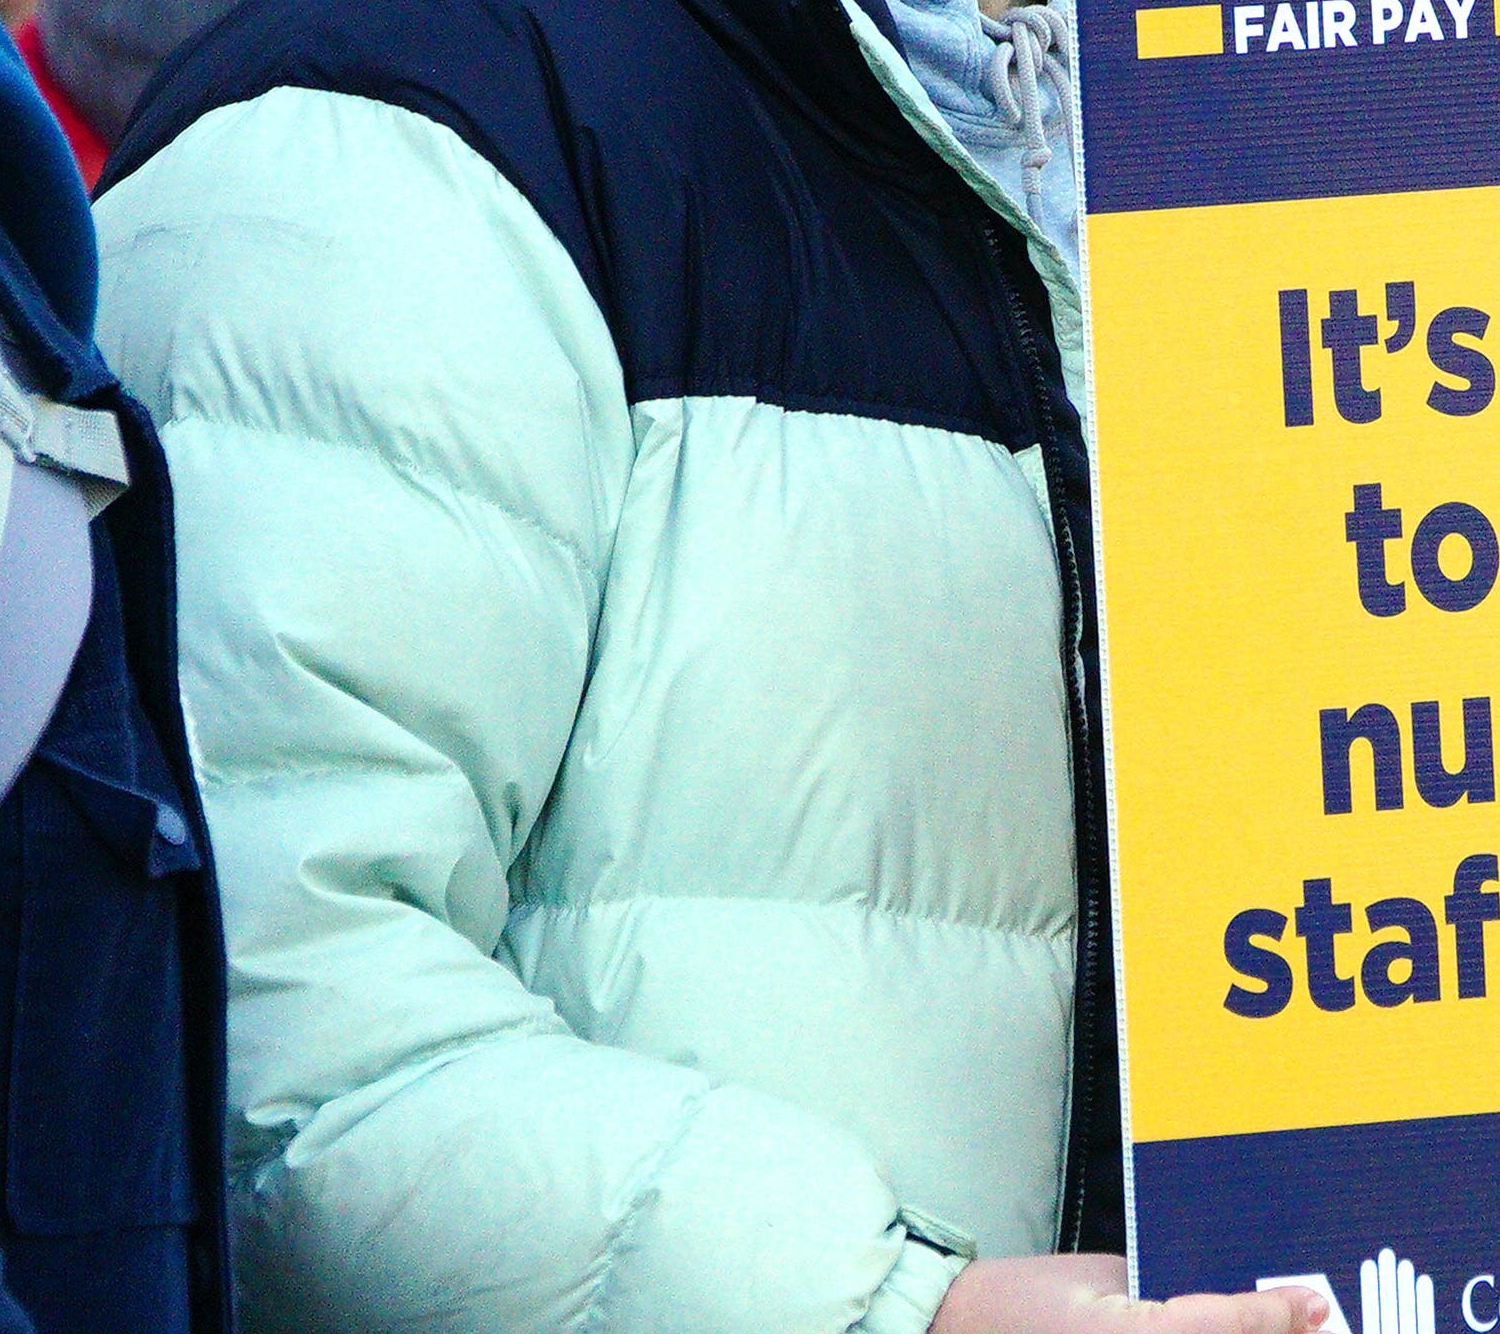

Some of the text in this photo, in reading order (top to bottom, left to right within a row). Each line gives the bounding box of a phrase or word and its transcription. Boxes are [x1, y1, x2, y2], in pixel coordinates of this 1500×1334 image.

[1234, 0, 1357, 53] FAIR
[1279, 281, 1495, 427] It's
[1345, 483, 1499, 617] to
